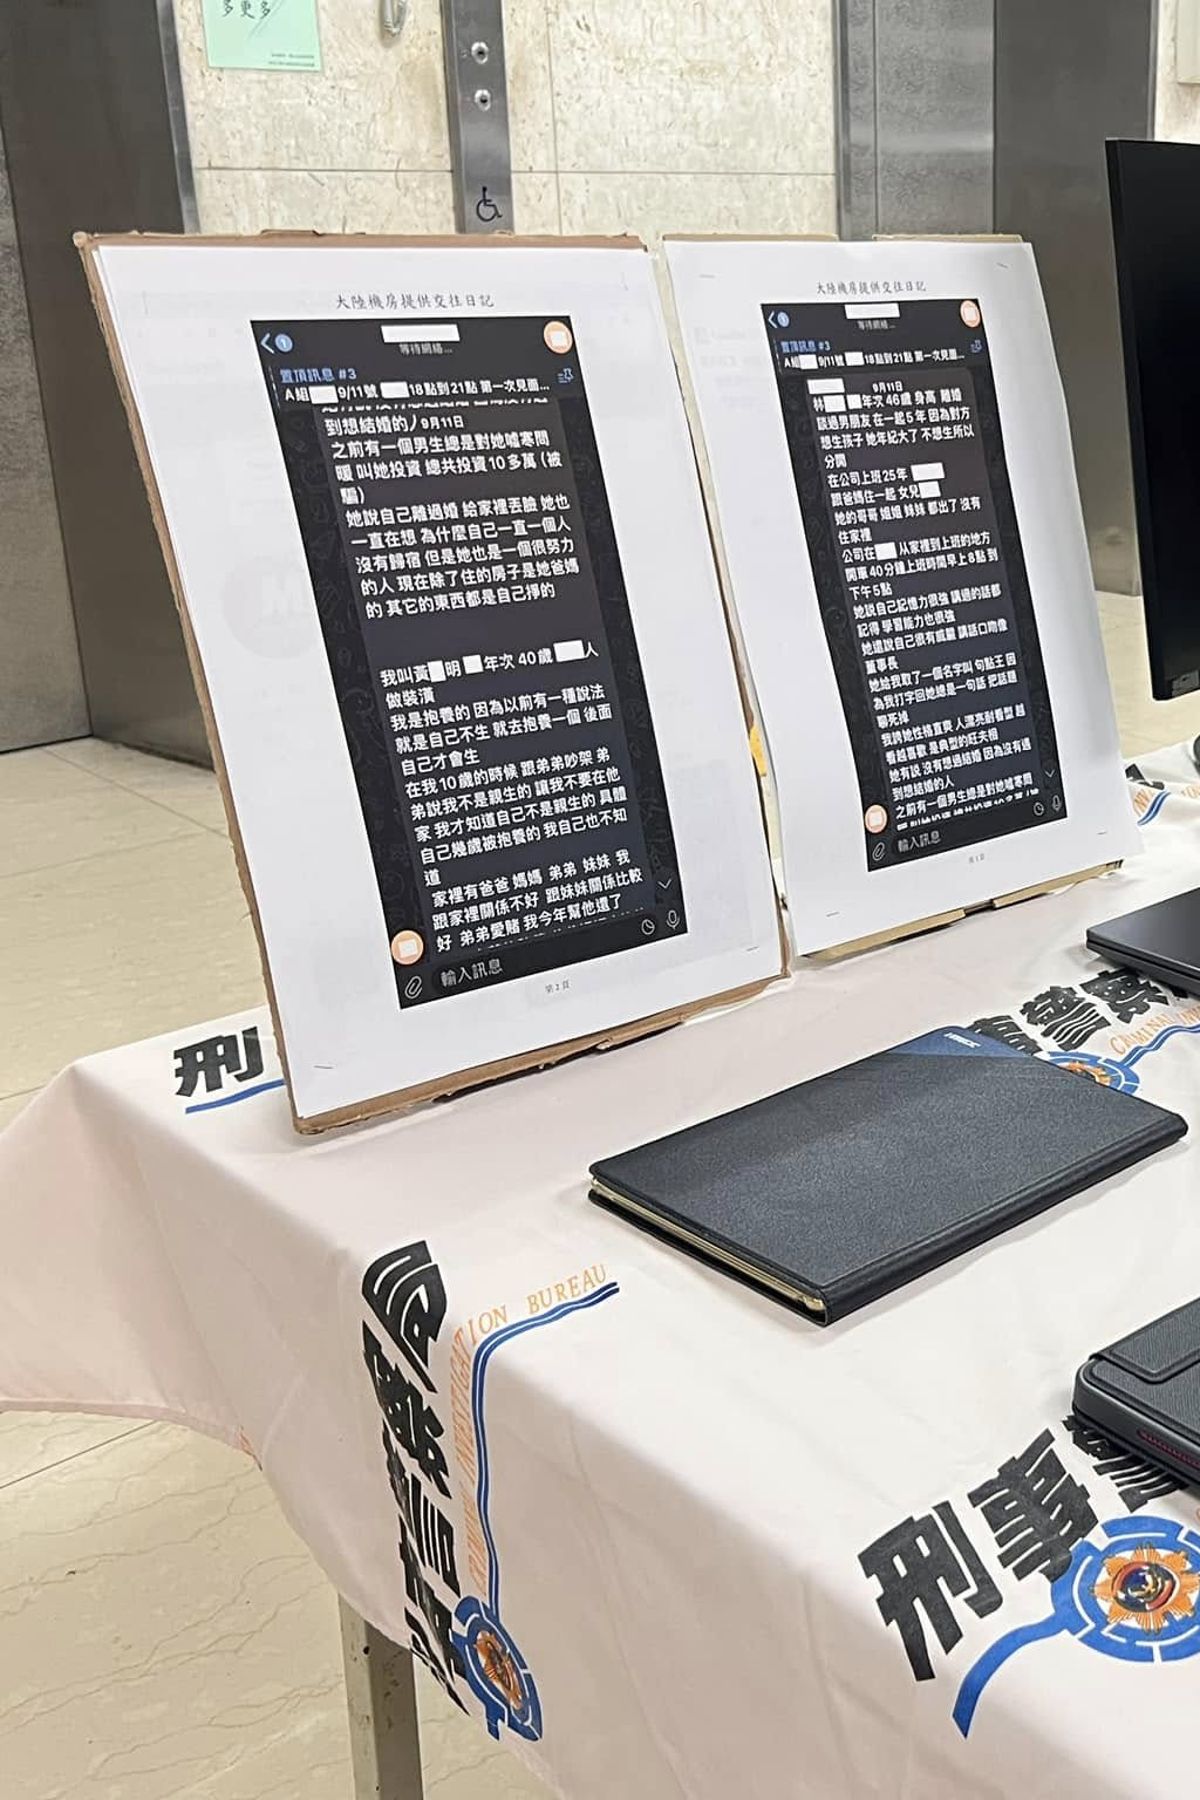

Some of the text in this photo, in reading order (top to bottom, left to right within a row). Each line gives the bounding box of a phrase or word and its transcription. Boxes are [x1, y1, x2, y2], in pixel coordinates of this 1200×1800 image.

[336, 291, 495, 310] 大陸機房提供交往日記
[279, 367, 356, 383] 置頂訊息 #3
[285, 386, 309, 401] A組
[420, 415, 463, 429] 9月11日
[334, 463, 353, 481] 暖
[355, 459, 421, 479] 叫她投資
[346, 502, 458, 527] 她說自己離過婚
[540, 493, 570, 511] 她也
[351, 515, 570, 549] 一直在想 為什麼自己一直一個人
[355, 537, 573, 573] 沒有歸宿 但是她也是一個很努力
[360, 557, 578, 595] 的人 現在除了住的房子是她爸媽
[365, 601, 382, 619] 的
[483, 653, 515, 671] 年次
[385, 686, 434, 709] 做裝潢
[390, 684, 604, 731] 我是抱養的 因為以前有一種說法
[395, 703, 611, 753] 就是自己不生 就去抱養一個 後面
[401, 748, 479, 775] 自己才會生
[520, 750, 592, 776] 跟弟弟吵架
[596, 746, 609, 762] 弟
[411, 766, 620, 820] 弟說我不是親生的 讓我不要在他
[414, 785, 626, 841] 家 我才知道自己不是親生的 具體
[421, 807, 626, 863] 自己幾歲被抱養的 我自己也不知
[423, 868, 441, 886] 道
[431, 848, 630, 907] 家裡有爸爸 媽媽 弟弟 妹妹 我
[432, 891, 538, 929] 跟家裡關係不好
[545, 868, 642, 902] 跟妹妹關係比較
[436, 934, 451, 952] 好
[523, 893, 620, 930] 我今年幫他還了
[440, 958, 502, 986] 輸入訊息
[526, 1263, 608, 1317] BUREAU
